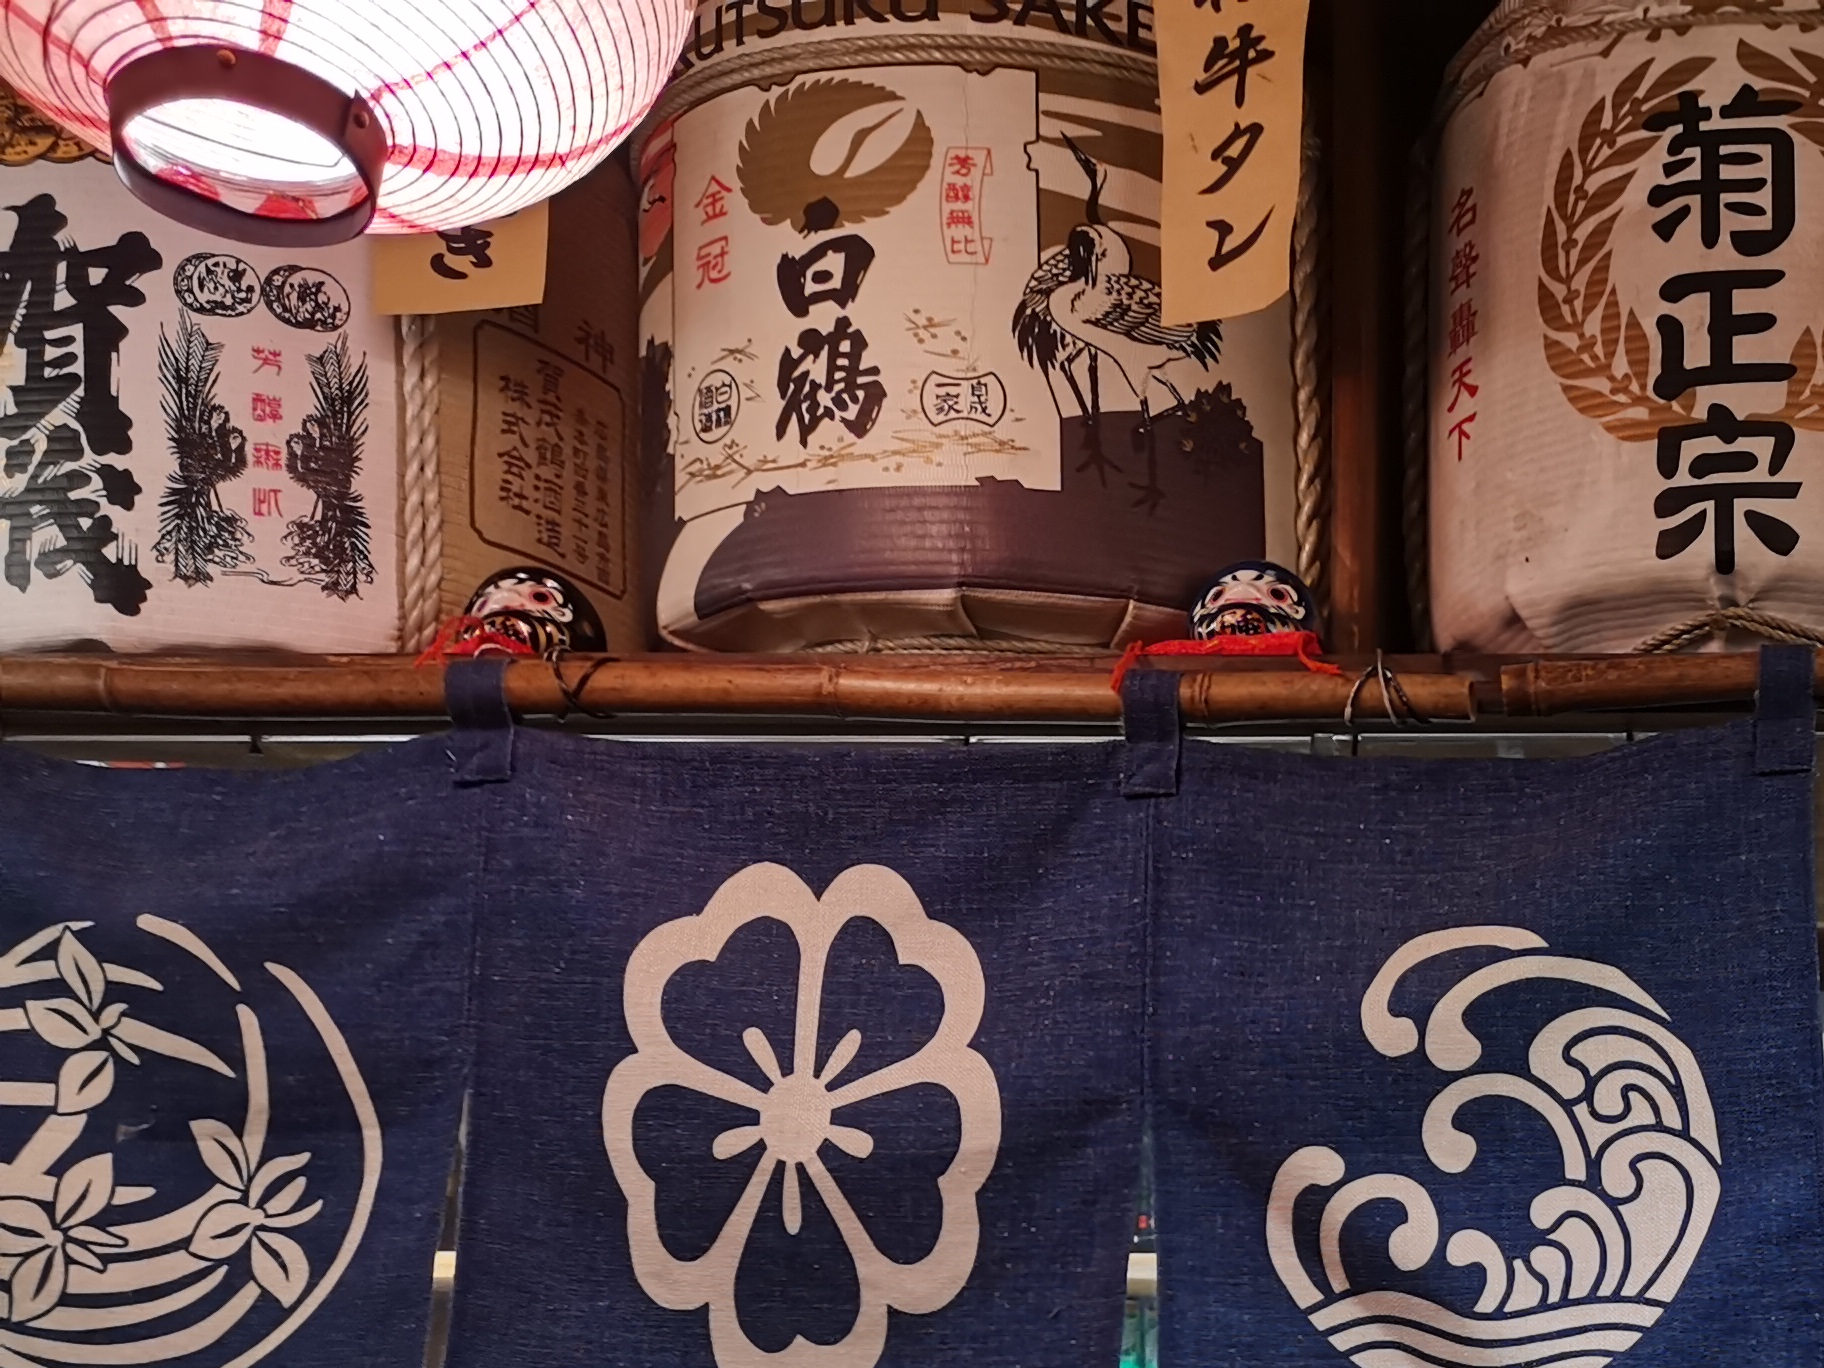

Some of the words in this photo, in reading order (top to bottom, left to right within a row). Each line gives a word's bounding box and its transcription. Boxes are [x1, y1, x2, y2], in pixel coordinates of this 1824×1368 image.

[676, 0, 940, 69] UTSURU
[1194, 0, 1275, 271] 牛タン
[693, 174, 734, 291] 金冠
[775, 195, 889, 449] 白鶴
[1641, 84, 1803, 575] 菊正宗
